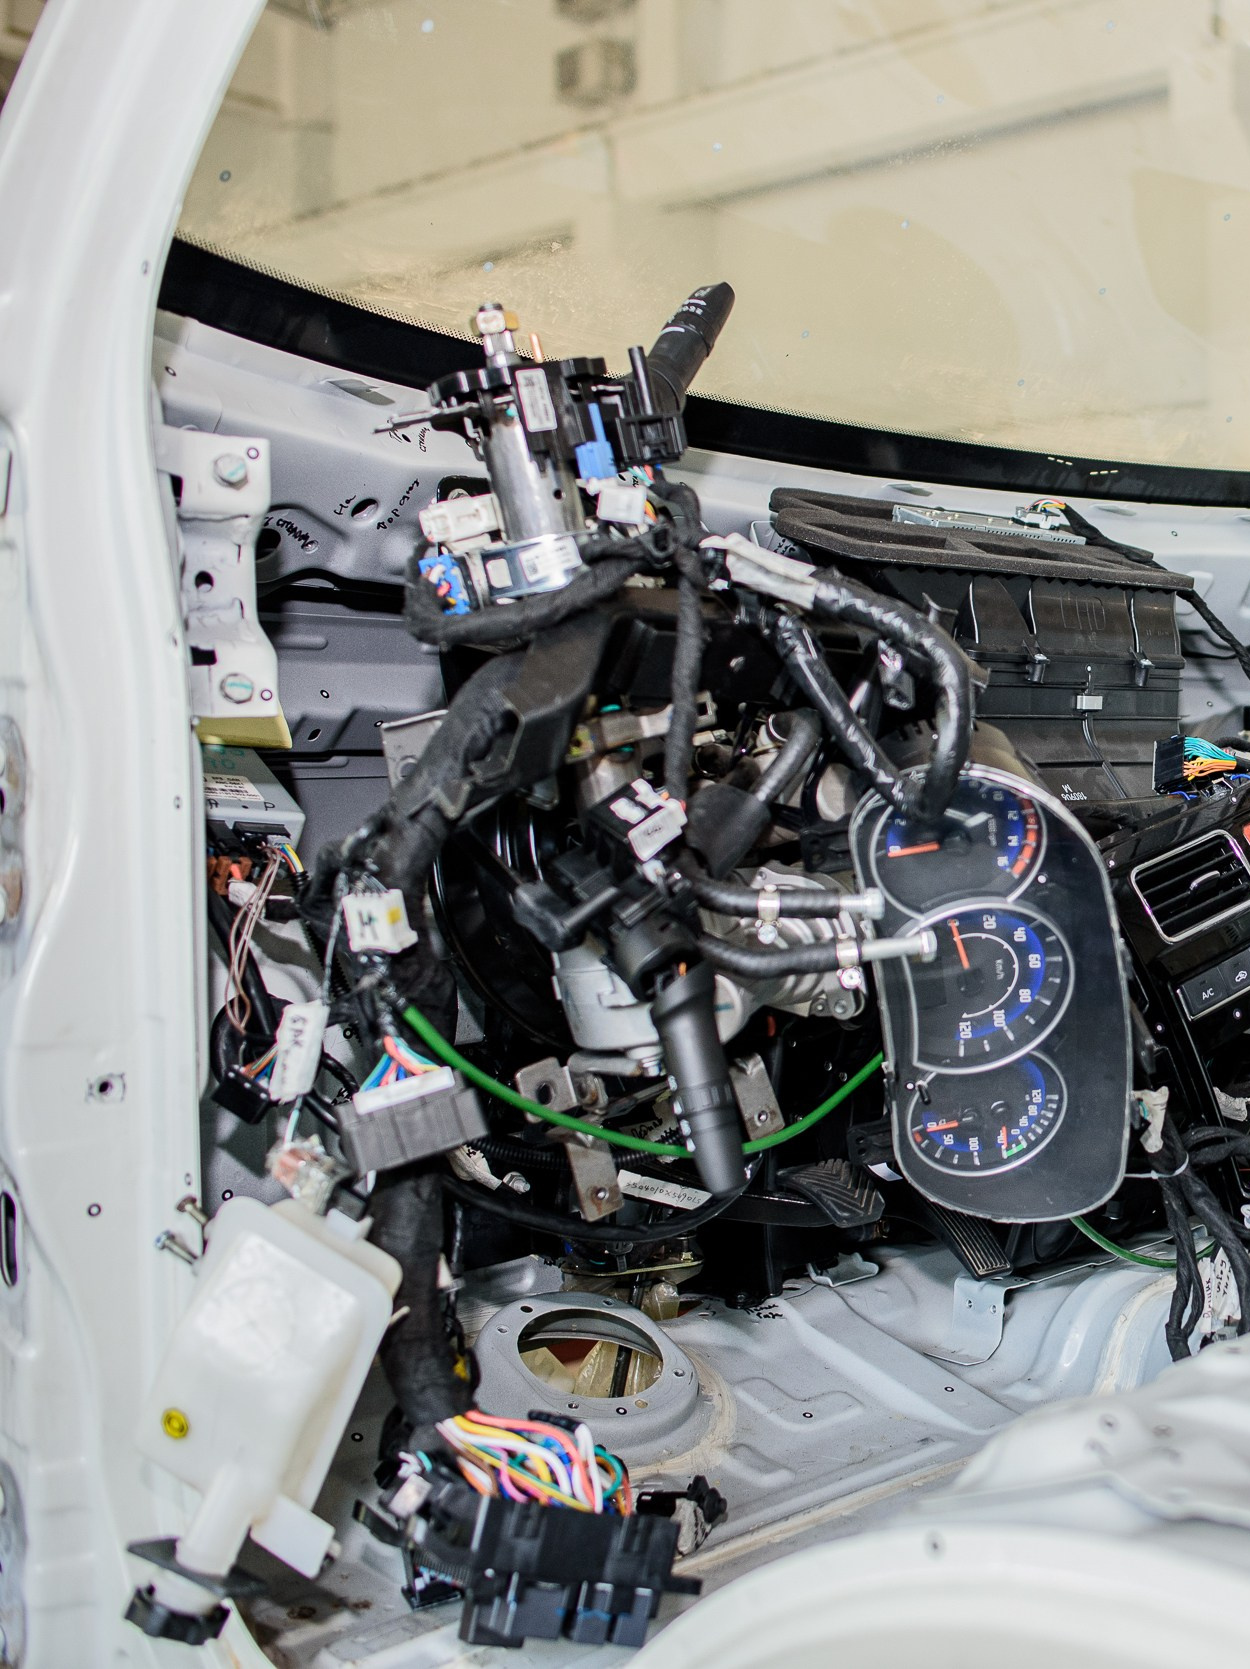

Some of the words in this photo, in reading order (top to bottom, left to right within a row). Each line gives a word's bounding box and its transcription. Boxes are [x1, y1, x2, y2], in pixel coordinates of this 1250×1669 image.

[1007, 810, 1019, 821] 12
[1007, 835, 1019, 847] 14
[997, 856, 1009, 867] 16
[982, 914, 997, 930] 20
[1013, 926, 1027, 942] 40
[1028, 953, 1042, 969] 60
[1019, 988, 1032, 1003] 80
[1202, 987, 1215, 1001] A/C
[993, 1009, 1006, 1027] 100
[959, 1020, 972, 1039] 120
[1031, 1088, 1043, 1103] 120
[1028, 1104, 1038, 1116] 80
[1019, 1115, 1029, 1127] 40
[943, 1133, 954, 1145] 50
[969, 1136, 979, 1151] 100
